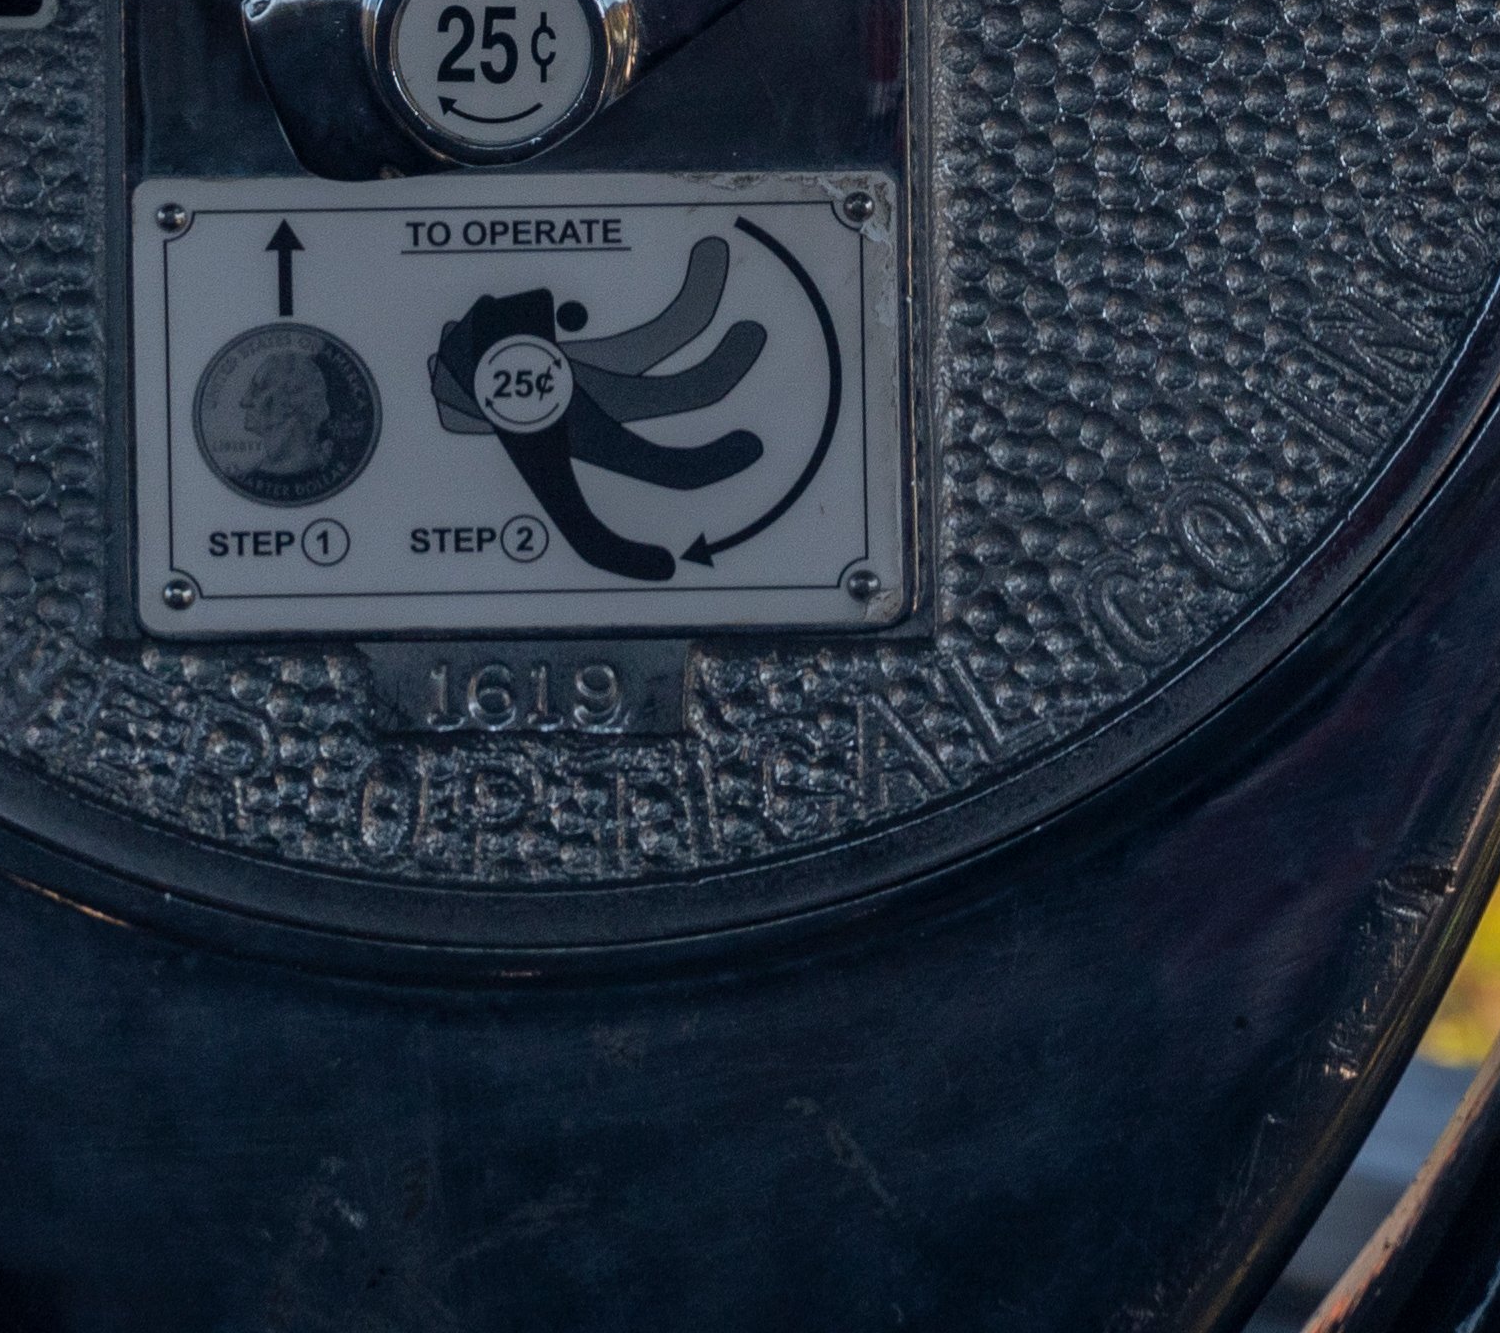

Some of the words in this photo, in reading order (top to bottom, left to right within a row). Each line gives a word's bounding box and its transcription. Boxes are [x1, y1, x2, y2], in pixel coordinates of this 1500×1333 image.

[438, 6, 555, 84] 25¢
[406, 222, 451, 246] TO
[463, 219, 621, 246] OPERATE
[491, 367, 557, 400] 25¢
[210, 531, 294, 556] STEP
[411, 528, 496, 553] STEP
[517, 527, 533, 551] 2
[428, 663, 625, 732] 1619
